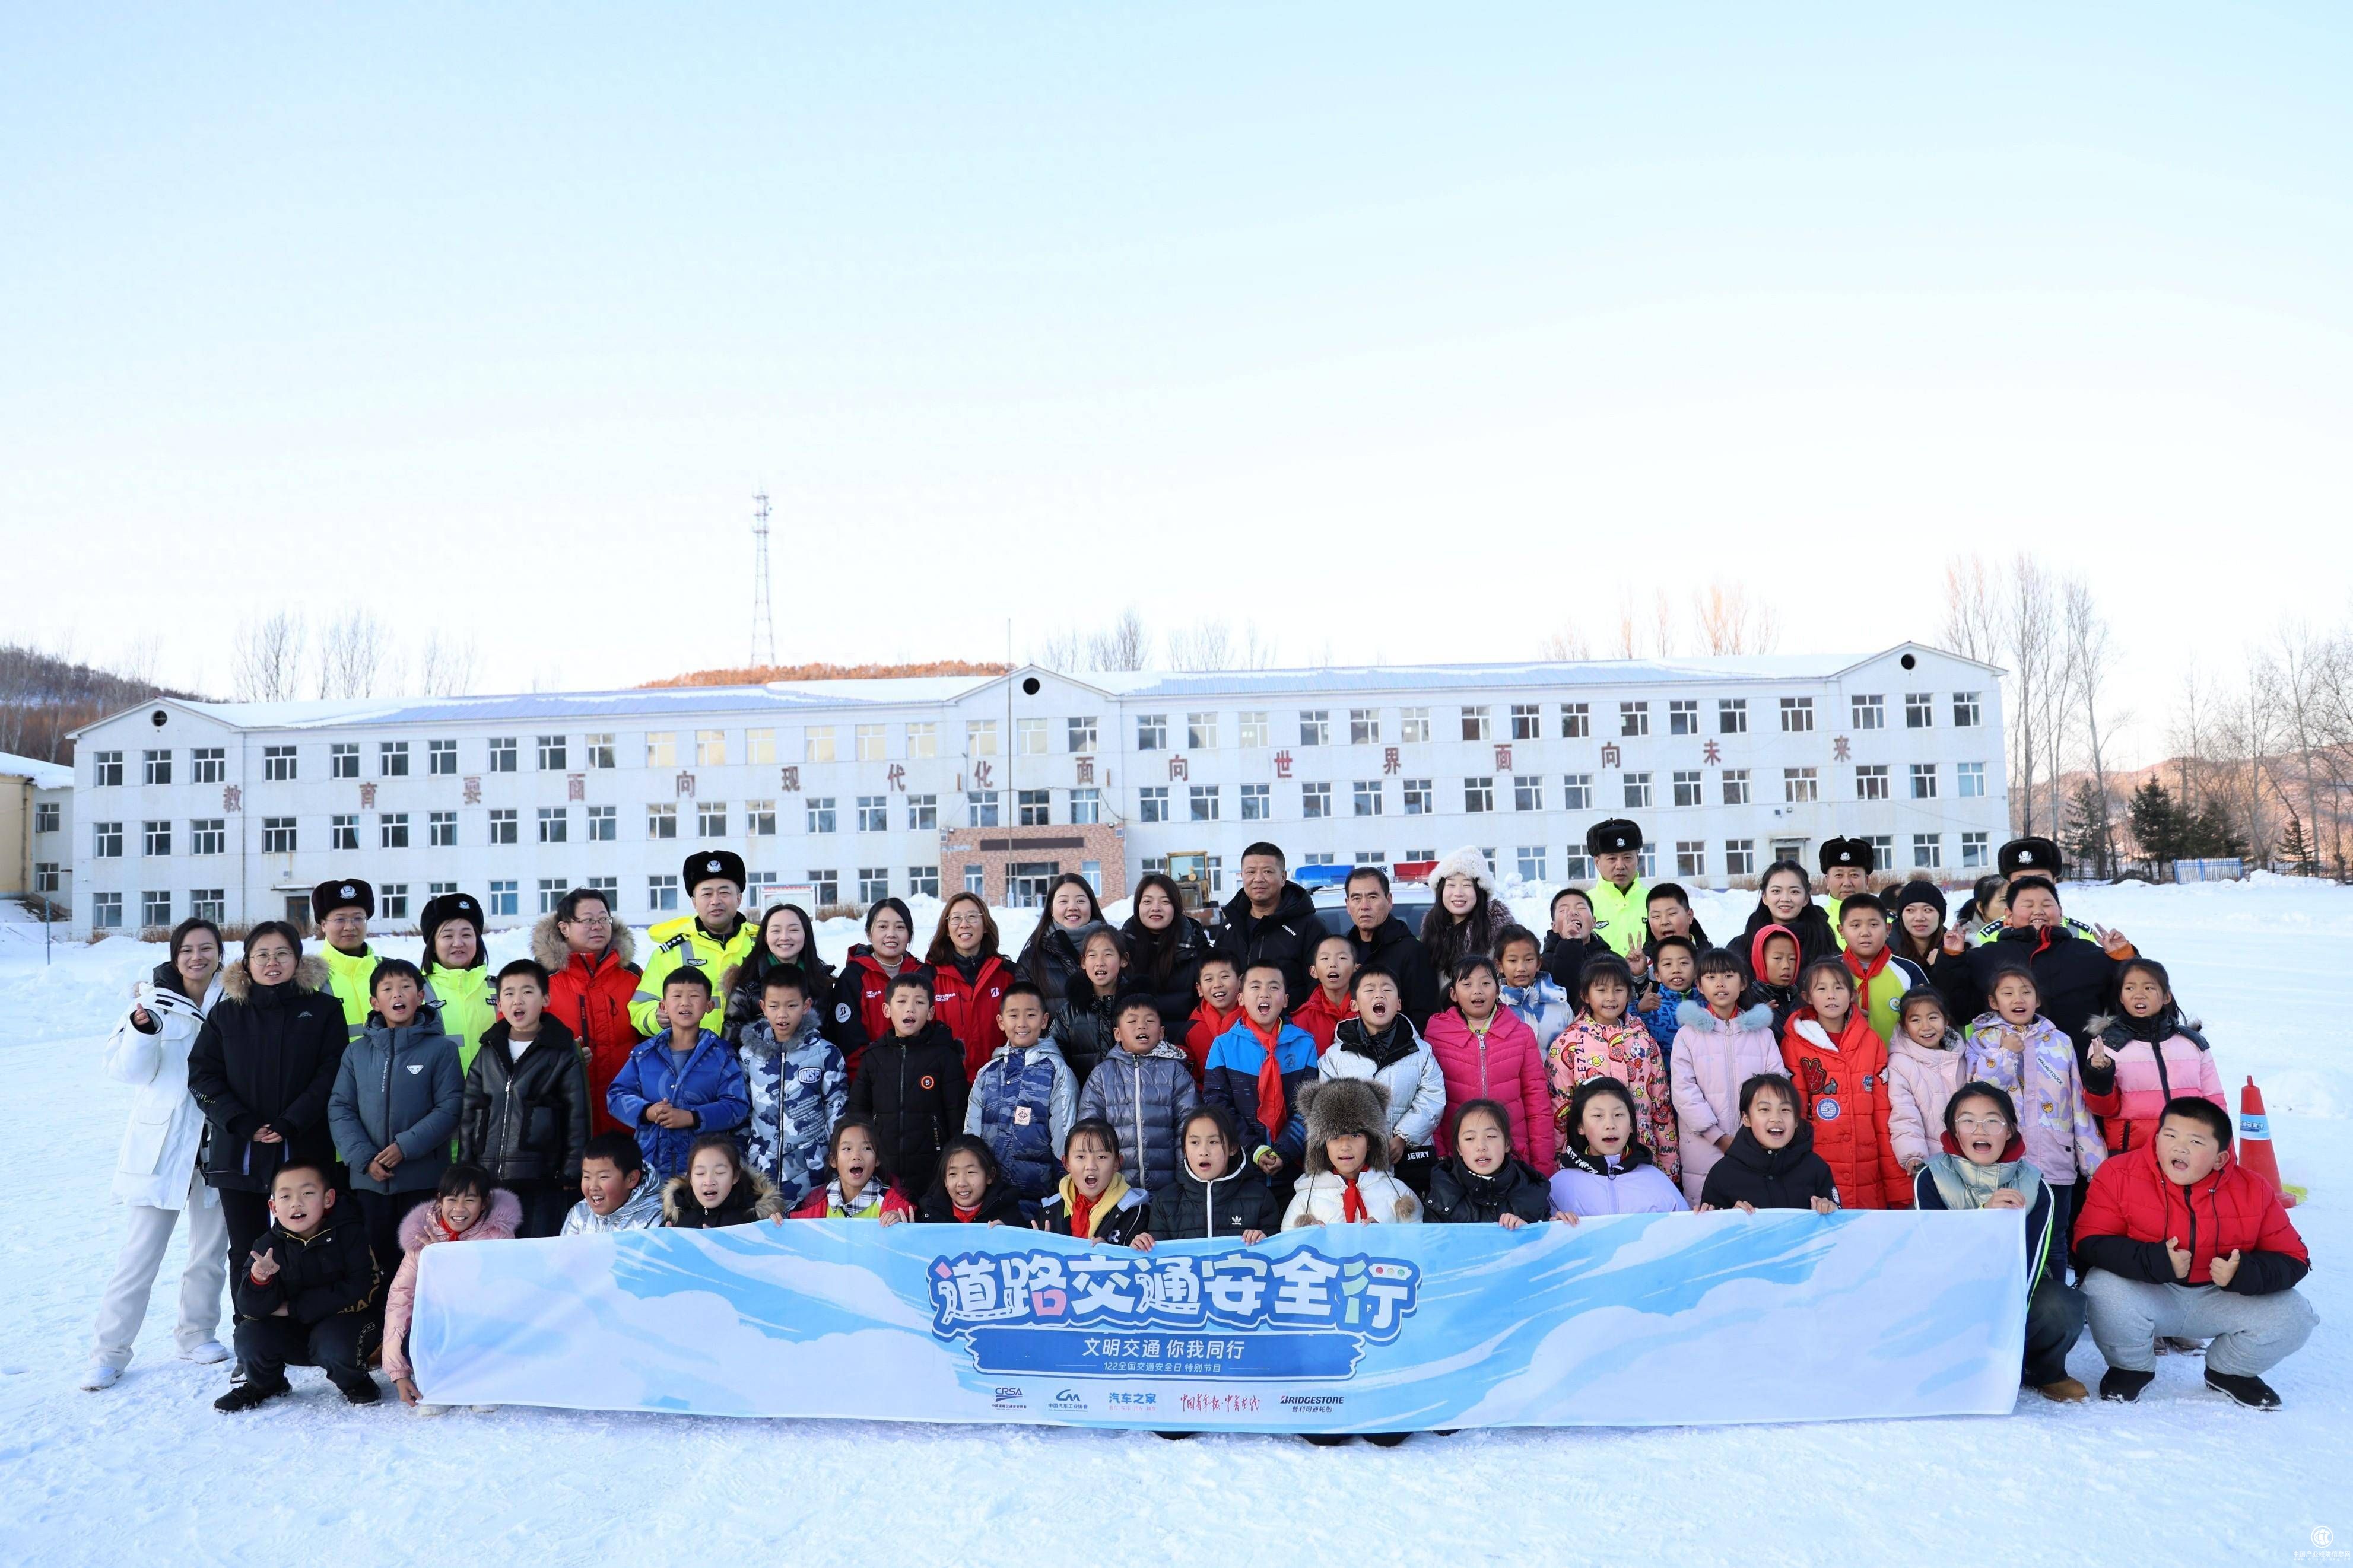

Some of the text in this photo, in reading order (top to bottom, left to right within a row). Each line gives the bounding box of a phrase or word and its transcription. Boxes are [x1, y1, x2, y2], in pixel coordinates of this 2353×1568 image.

[1407, 1151, 1429, 1160] JERRY
[932, 1249, 1412, 1330] 道路交通安全行
[1082, 1338, 1245, 1359] 文明交通 你我同行
[1104, 1362, 1221, 1373] 122全国交通安全日 特别节目
[1109, 1393, 1157, 1404] 汽车之家
[1280, 1395, 1345, 1404] BRIDGESTONE
